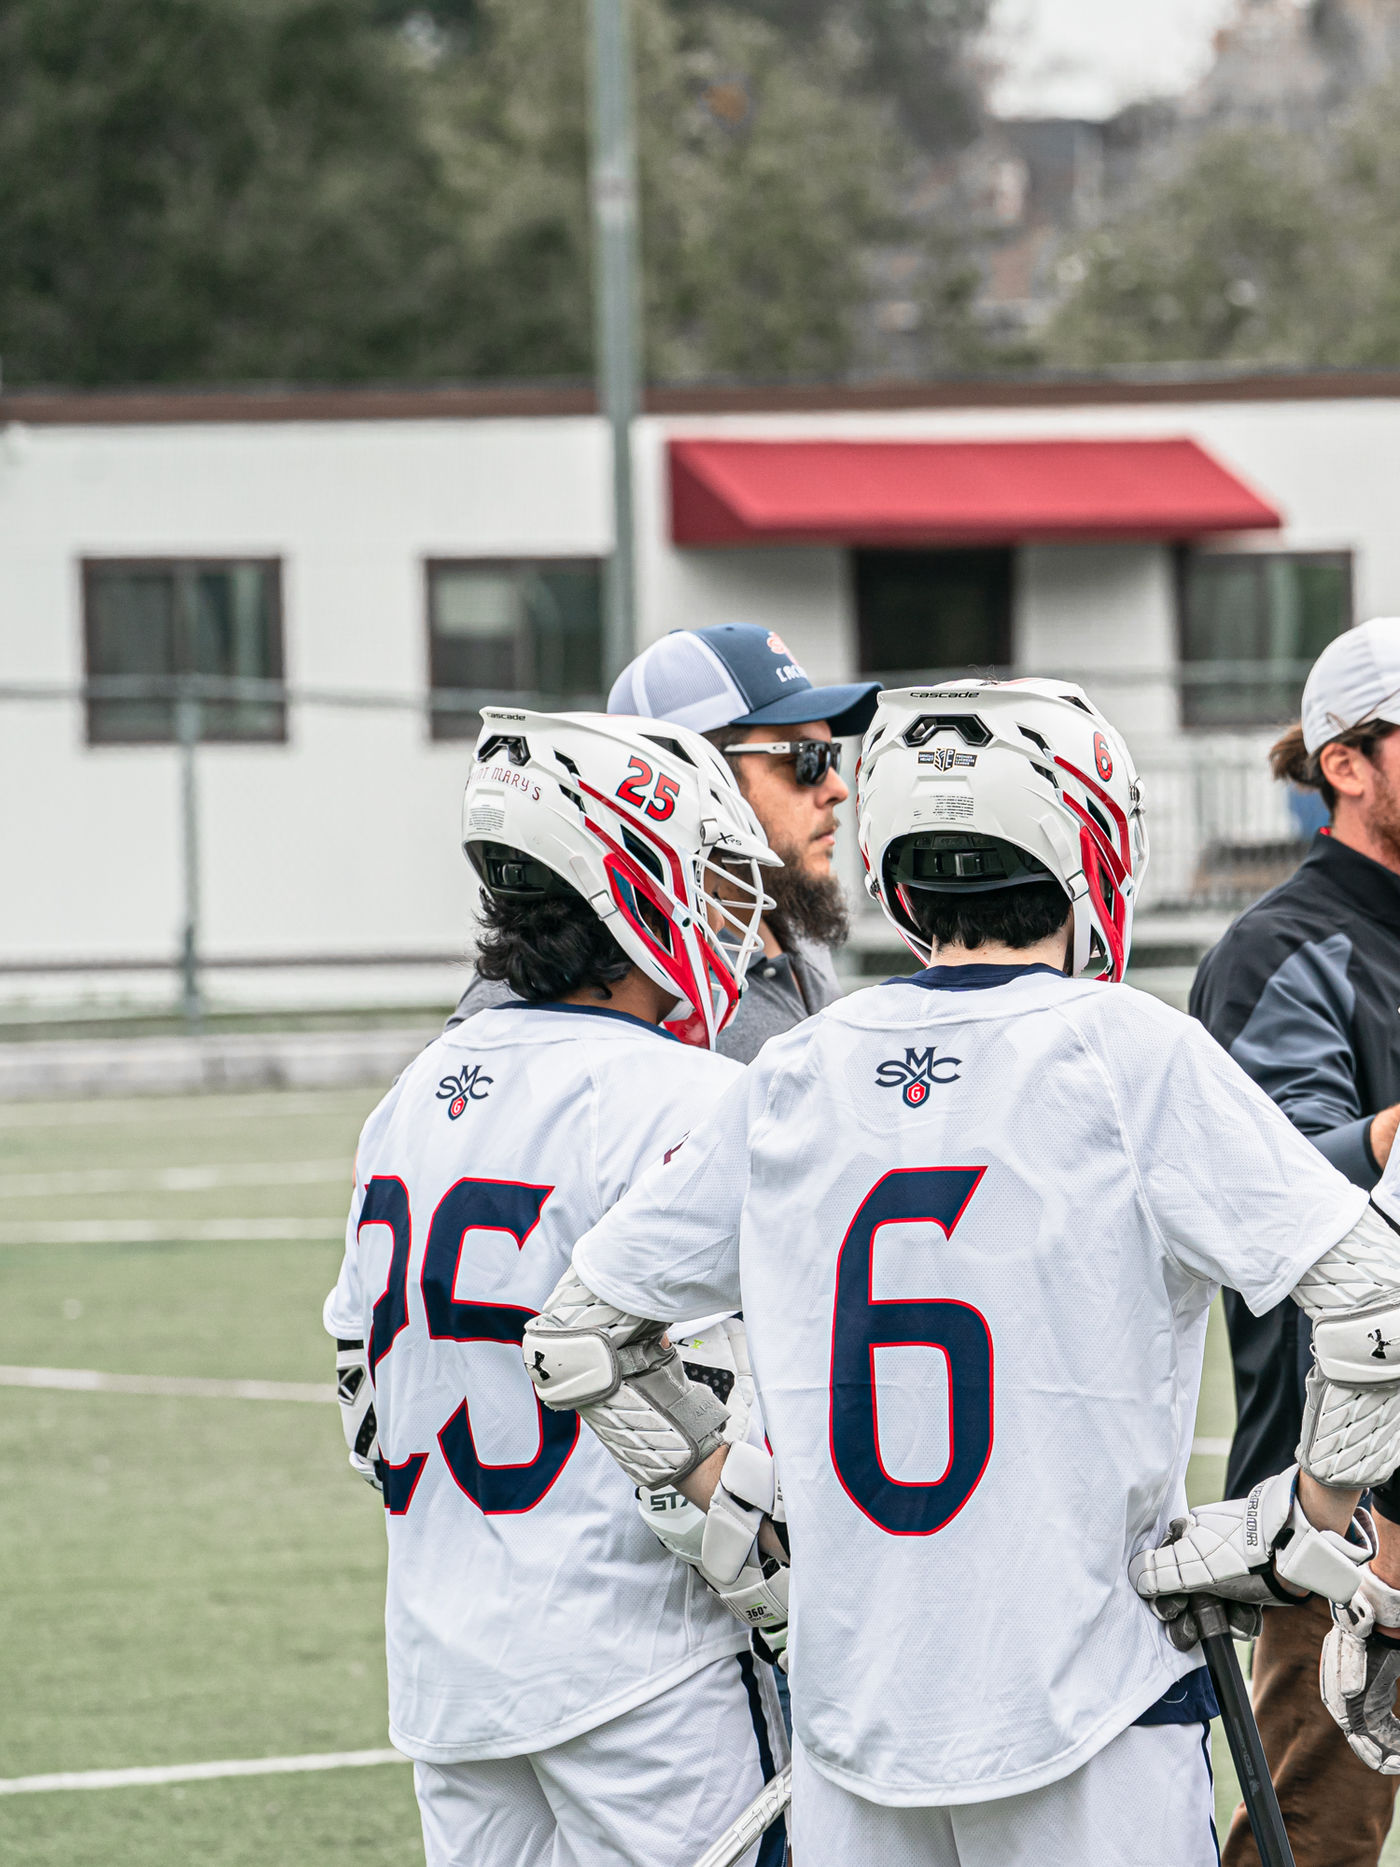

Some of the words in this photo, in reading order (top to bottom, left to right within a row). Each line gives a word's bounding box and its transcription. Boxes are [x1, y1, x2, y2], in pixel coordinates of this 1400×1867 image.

[910, 691, 980, 699] cascade
[1093, 731, 1113, 782] 6
[615, 755, 680, 822] 25
[435, 1065, 494, 1099] SMC
[875, 1046, 962, 1087] SMC
[911, 1086, 921, 1100] G
[357, 1175, 580, 1516] 25
[829, 1166, 994, 1536] 6
